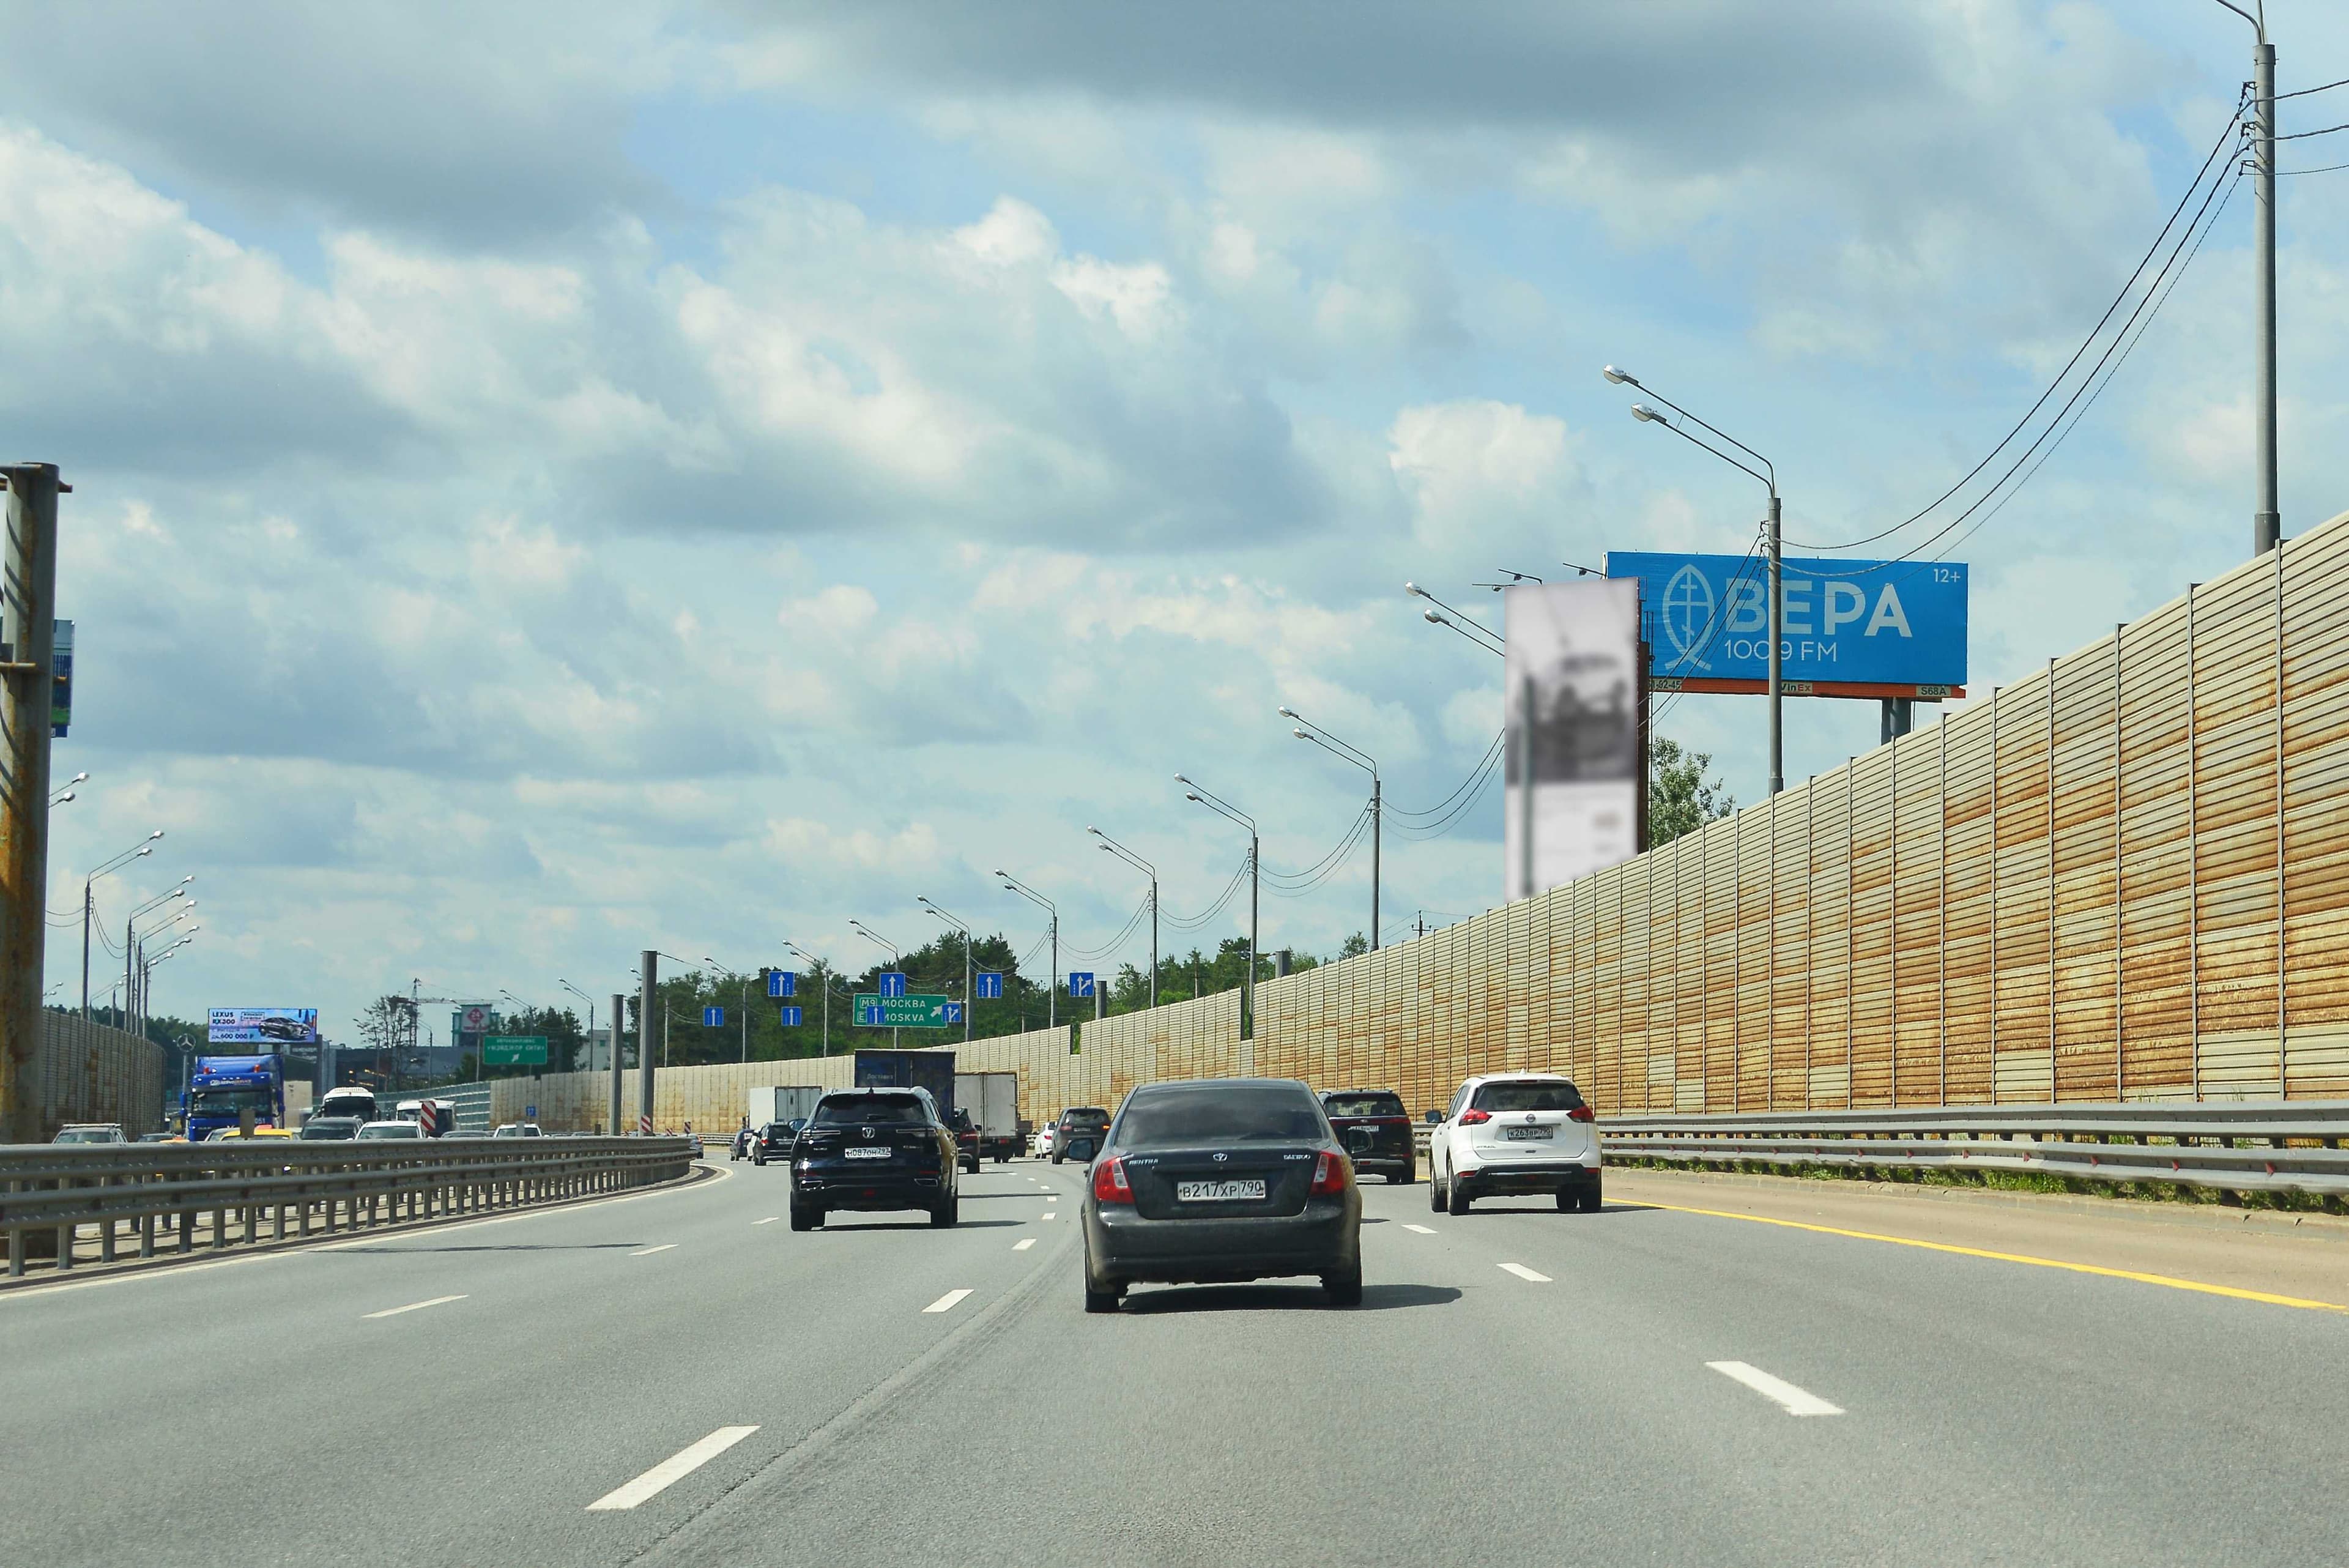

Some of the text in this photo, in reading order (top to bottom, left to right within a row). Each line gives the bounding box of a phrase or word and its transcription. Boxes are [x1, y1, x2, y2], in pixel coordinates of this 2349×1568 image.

[1934, 568, 1961, 583] 12+
[1726, 578, 1913, 637] ВЕРА
[1725, 639, 1836, 662] 1009 FM
[1921, 686, 1946, 695] S68A
[882, 999, 926, 1008] МОСКВА
